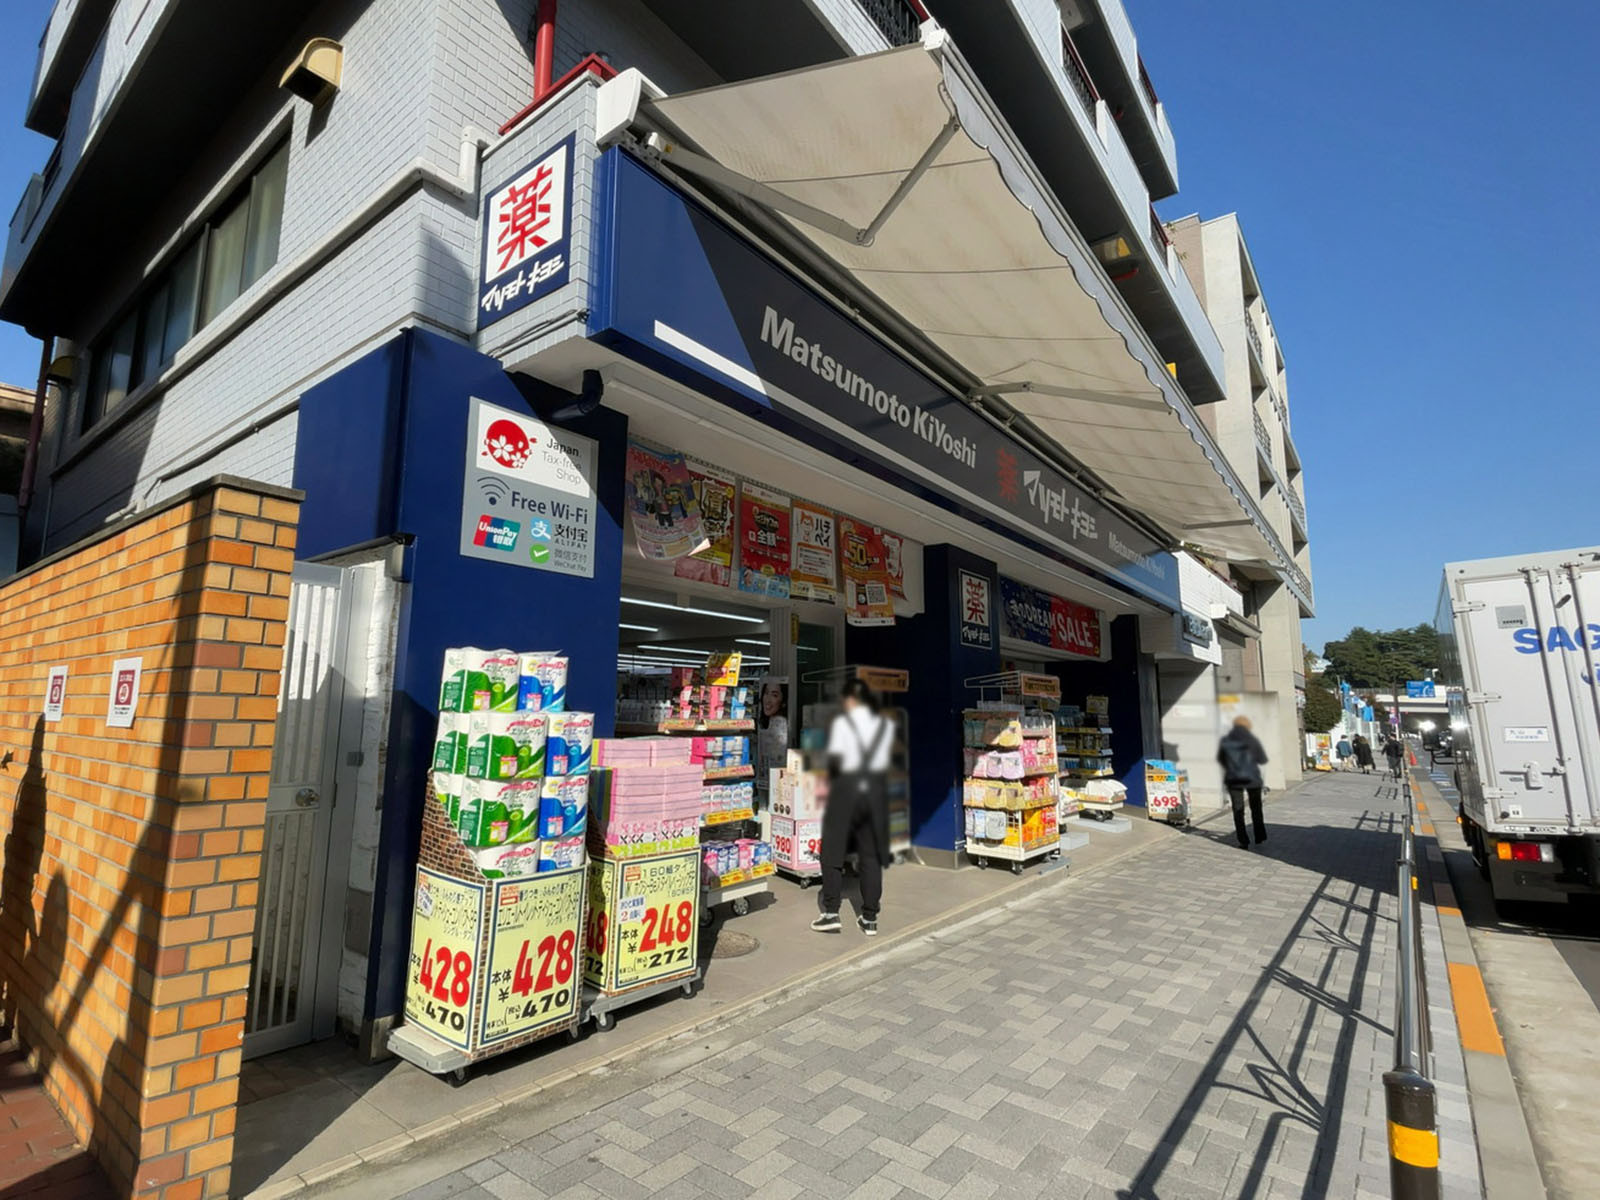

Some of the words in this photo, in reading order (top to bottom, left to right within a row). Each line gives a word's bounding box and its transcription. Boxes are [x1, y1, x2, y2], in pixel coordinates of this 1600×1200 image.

[497, 163, 553, 272] 薬
[759, 305, 911, 427] Matsumoto
[913, 405, 976, 468] KiYoshi
[542, 451, 582, 471] Tax-free
[556, 468, 581, 486] Shop
[511, 491, 546, 514] Free
[550, 501, 588, 525] Wi-Fi
[479, 521, 517, 540] UnionPay
[554, 523, 588, 543] 支付宝
[1108, 532, 1145, 567] Matsumoto
[966, 577, 985, 624] 薬
[1056, 613, 1093, 648] SALE
[1153, 796, 1179, 808] 698
[775, 835, 791, 854] 980
[639, 900, 692, 952] 248
[419, 938, 473, 1008] 428
[491, 968, 512, 985] 本体
[511, 929, 575, 998] 428
